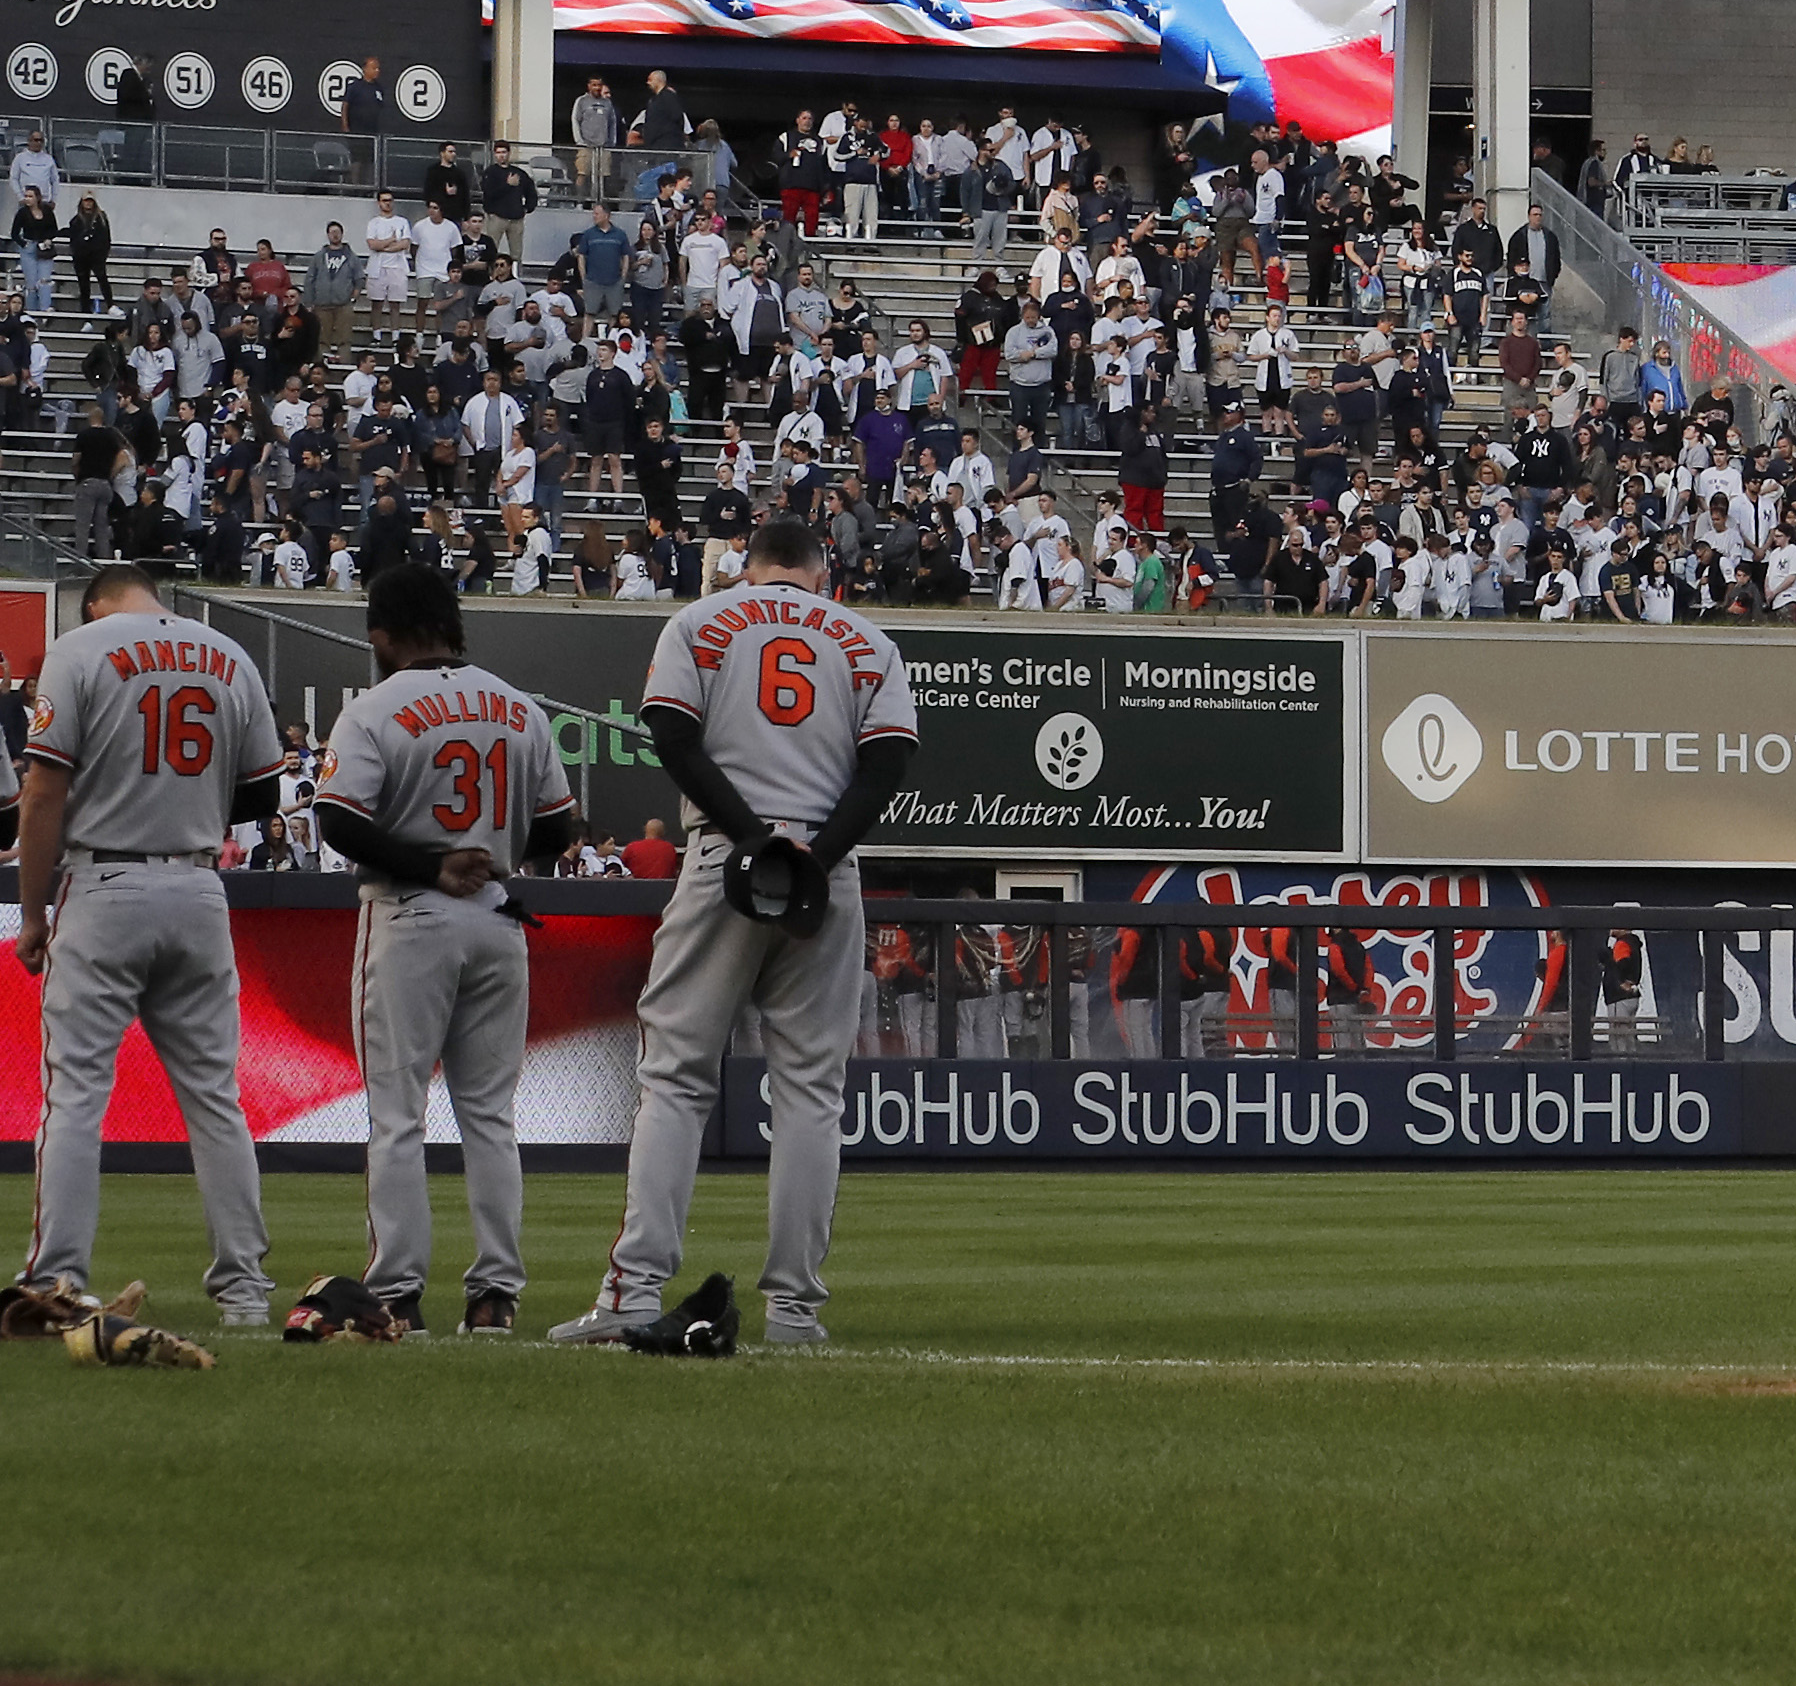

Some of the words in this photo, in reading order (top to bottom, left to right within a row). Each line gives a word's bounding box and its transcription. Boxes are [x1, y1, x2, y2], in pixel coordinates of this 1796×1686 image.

[14, 57, 48, 86] 42
[176, 66, 203, 94] 51
[250, 70, 283, 98] 46
[413, 79, 428, 107] 2
[107, 639, 236, 687] MANCINI
[692, 598, 884, 692] MOUNTCASTLE
[757, 635, 817, 727] 6
[906, 657, 993, 686] men's
[1002, 658, 1092, 687] Circle
[1124, 661, 1317, 695] Morningside
[391, 690, 528, 739] MULLINS
[911, 688, 970, 708] tiCare
[974, 690, 1041, 711] Center
[1119, 695, 1167, 713] Nursing
[1168, 696, 1191, 710] and
[1193, 697, 1277, 712] Rehabilitation
[1279, 699, 1320, 713] Center
[137, 684, 217, 777] 16
[1504, 729, 1700, 774] LOTTE
[432, 738, 508, 833] 31
[965, 793, 1082, 829] Matters
[1198, 796, 1272, 831] You!
[758, 1071, 1041, 1146] ubHub
[1071, 1070, 1370, 1147] StubHub
[1404, 1070, 1711, 1147] StubHub
